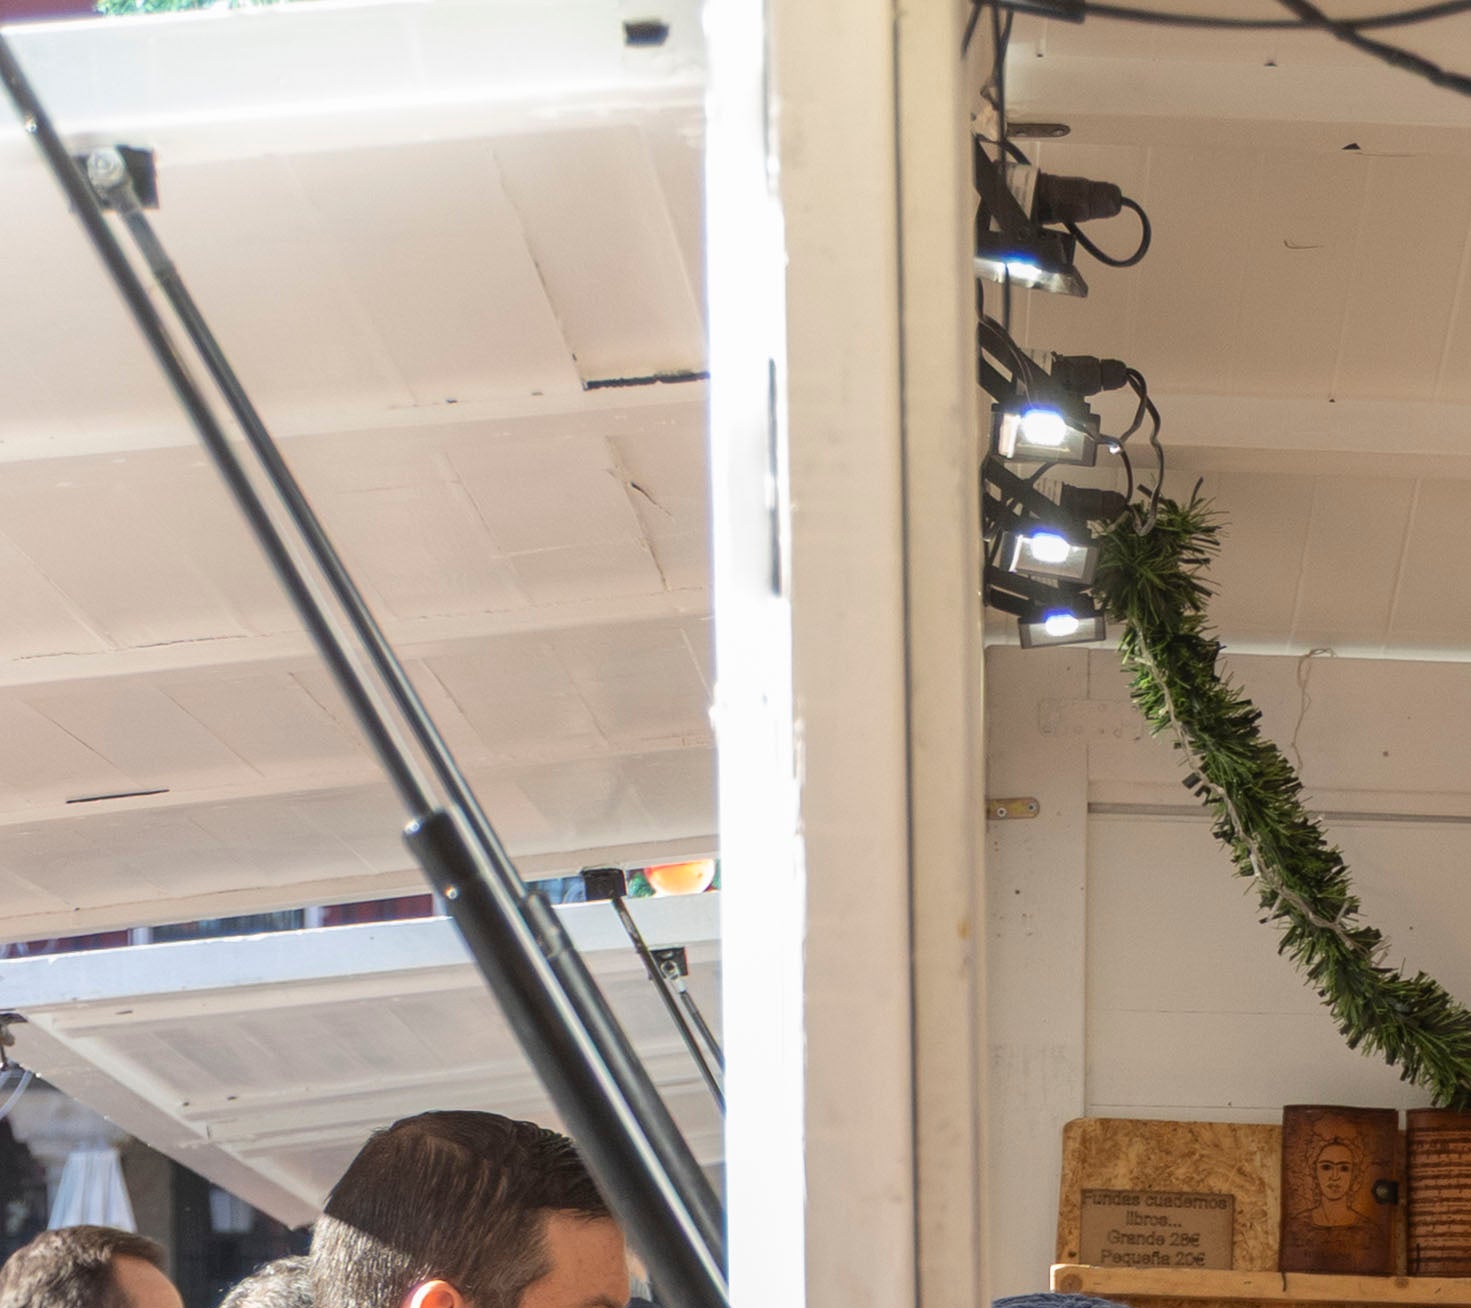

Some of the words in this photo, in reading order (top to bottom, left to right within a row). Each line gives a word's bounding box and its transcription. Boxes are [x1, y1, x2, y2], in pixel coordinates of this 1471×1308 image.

[1082, 1191, 1141, 1207] Fundas
[1145, 1193, 1228, 1210] cuadernos
[1107, 1229, 1166, 1247] Grande
[1100, 1249, 1170, 1267] Pequeña
[1175, 1251, 1206, 1267] 20€
